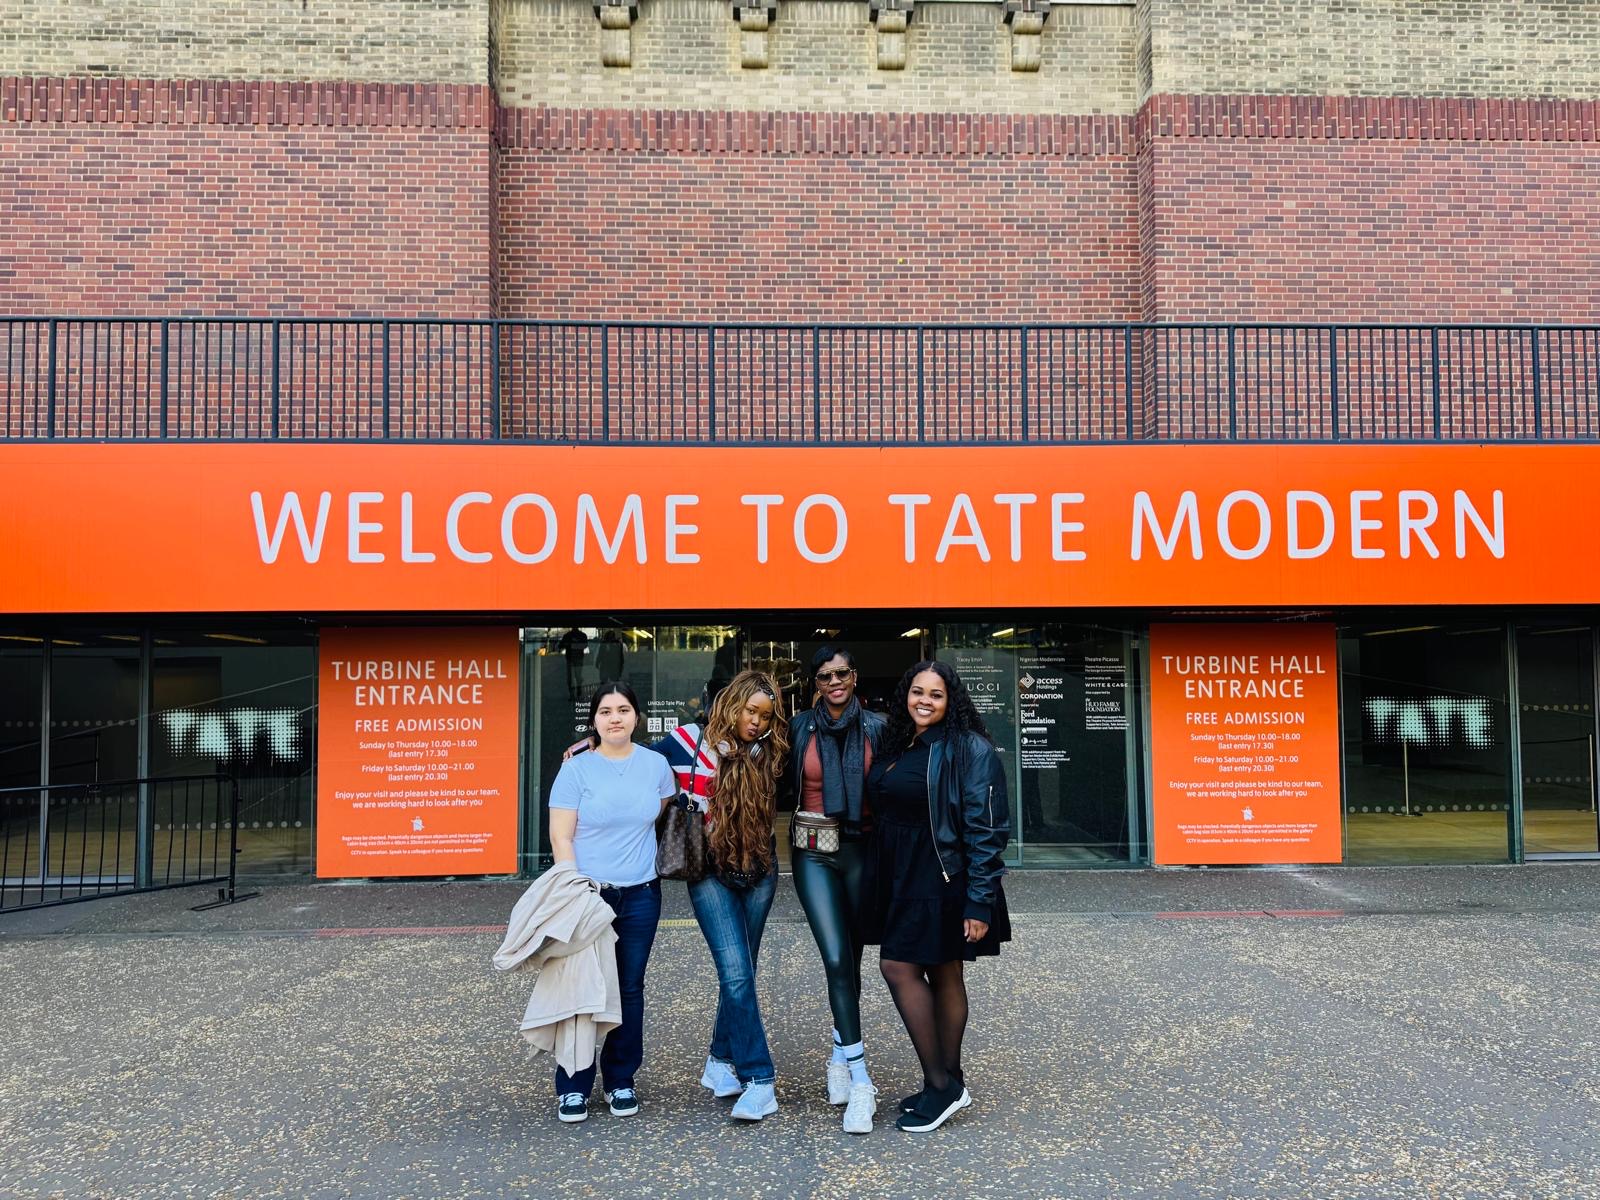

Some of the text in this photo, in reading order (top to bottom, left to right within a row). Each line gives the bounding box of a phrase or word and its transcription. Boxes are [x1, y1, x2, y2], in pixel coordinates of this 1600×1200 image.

[250, 490, 1506, 564] WELCOME TO TATE MODERN
[332, 660, 508, 680] TURBINE HALL
[1162, 656, 1325, 674] TURBINE HALL
[967, 683, 1000, 691] UCCI
[1185, 679, 1304, 698] ENTRANCE
[355, 684, 483, 705] ENTRANCE
[355, 718, 482, 732] FREE ADMISSION
[1186, 712, 1304, 724] FREE ADMISSION
[359, 742, 385, 750] Sunday
[396, 741, 430, 749] Thursday
[388, 751, 403, 759] (last
[426, 750, 447, 758] 17.30)
[377, 800, 406, 809] working
